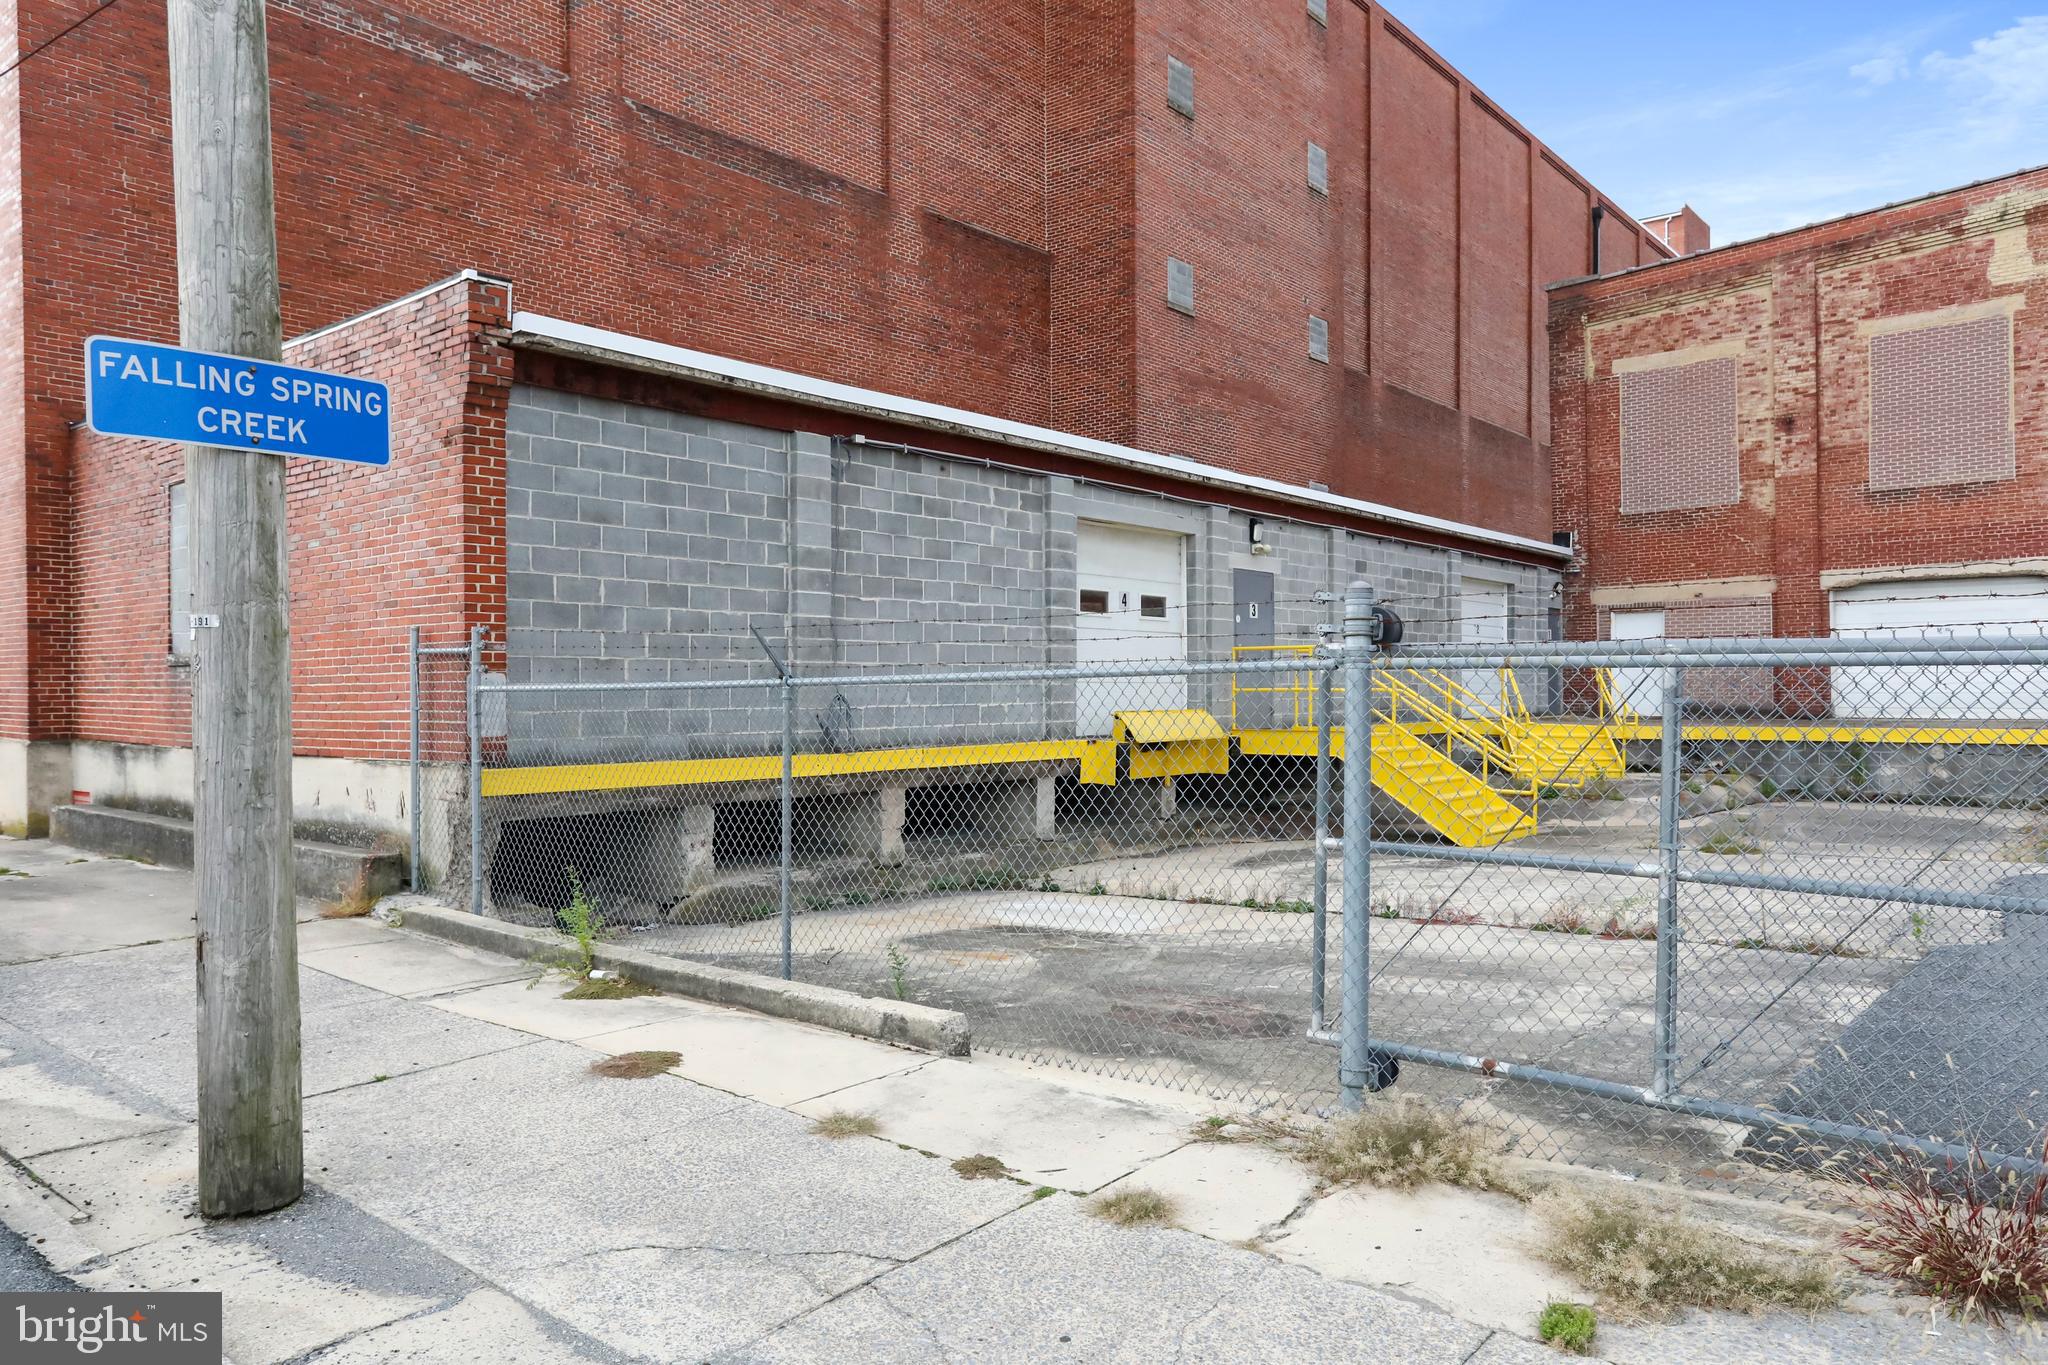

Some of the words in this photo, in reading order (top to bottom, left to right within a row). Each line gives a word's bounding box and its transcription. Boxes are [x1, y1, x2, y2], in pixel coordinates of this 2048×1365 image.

[99, 350, 255, 397] FALLING
[270, 375, 382, 417] SPRING
[197, 405, 308, 444] CREEK
[1121, 592, 1127, 607] 4
[1251, 603, 1256, 617] 3
